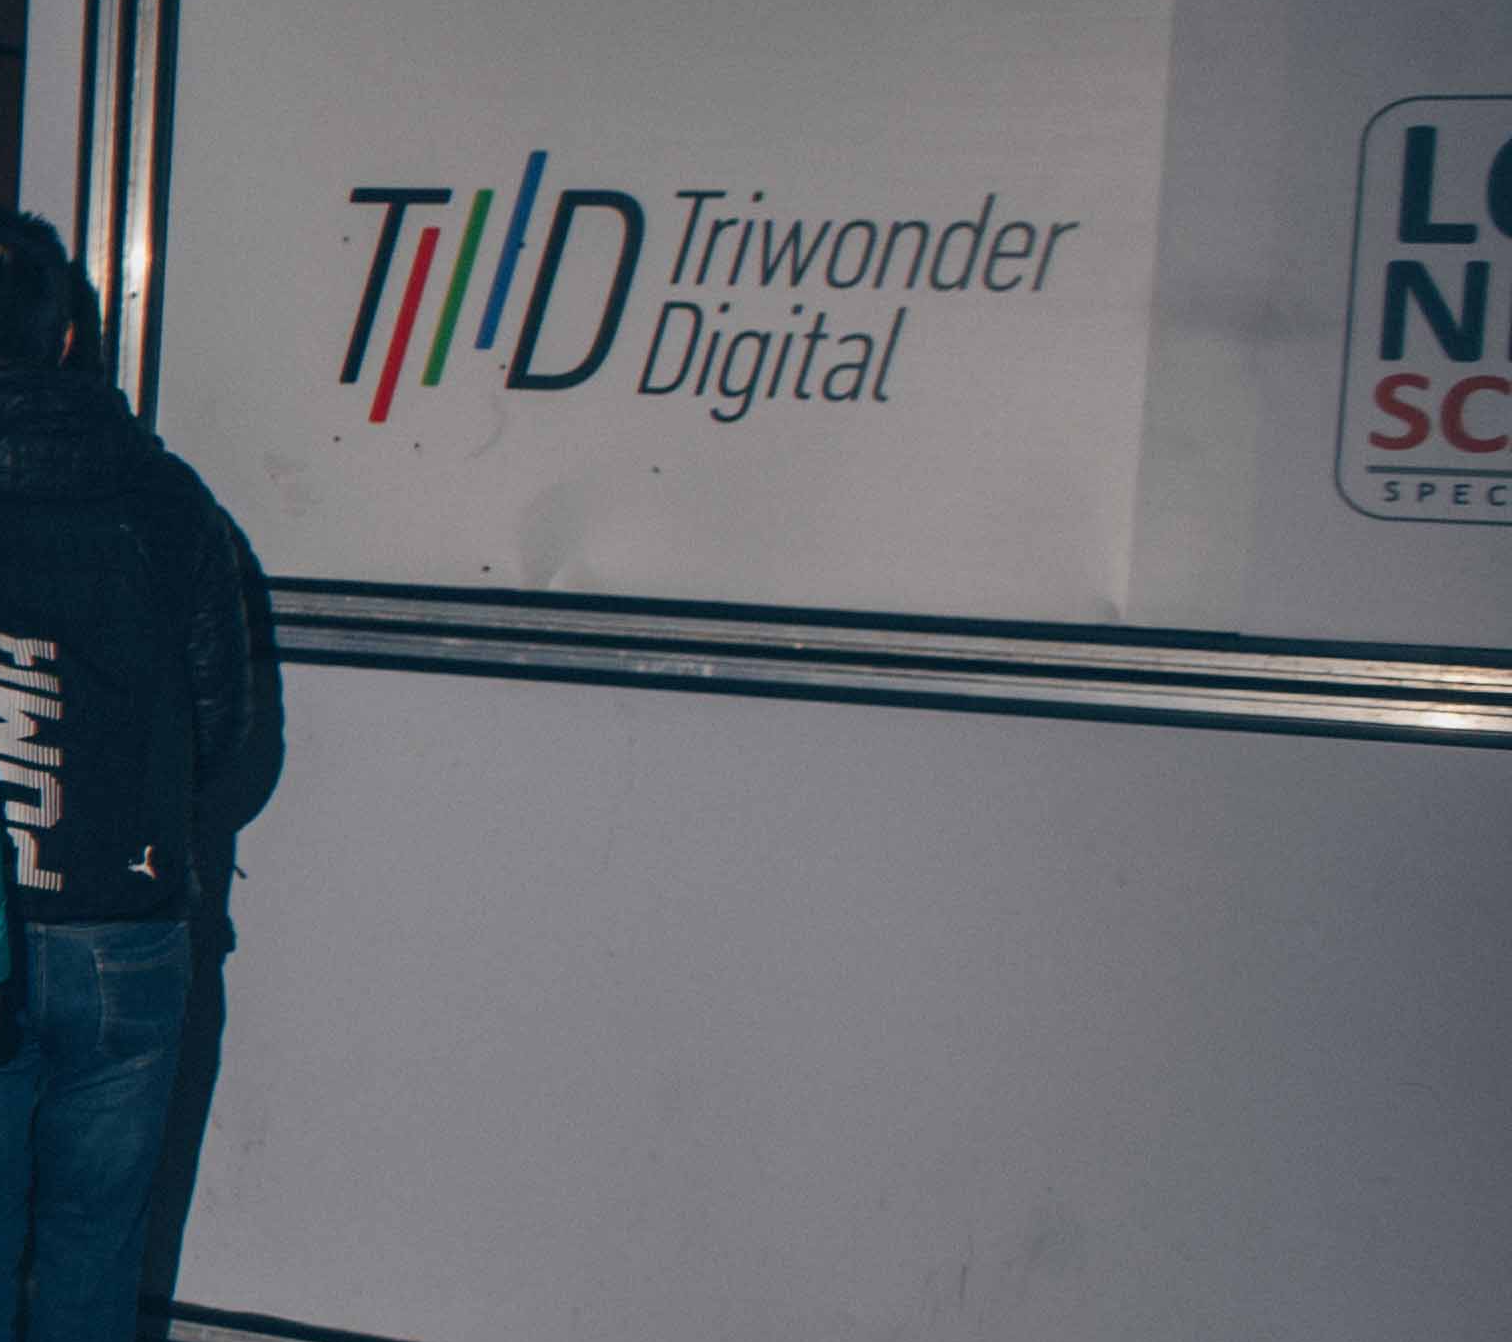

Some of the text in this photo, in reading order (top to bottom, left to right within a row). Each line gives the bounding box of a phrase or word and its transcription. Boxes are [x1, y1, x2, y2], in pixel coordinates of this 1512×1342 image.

[1396, 126, 1512, 245] L
[668, 190, 1080, 292] Triwonder
[637, 299, 907, 424] Digital
[1379, 261, 1512, 363] N
[1383, 482, 1510, 507] SPEC
